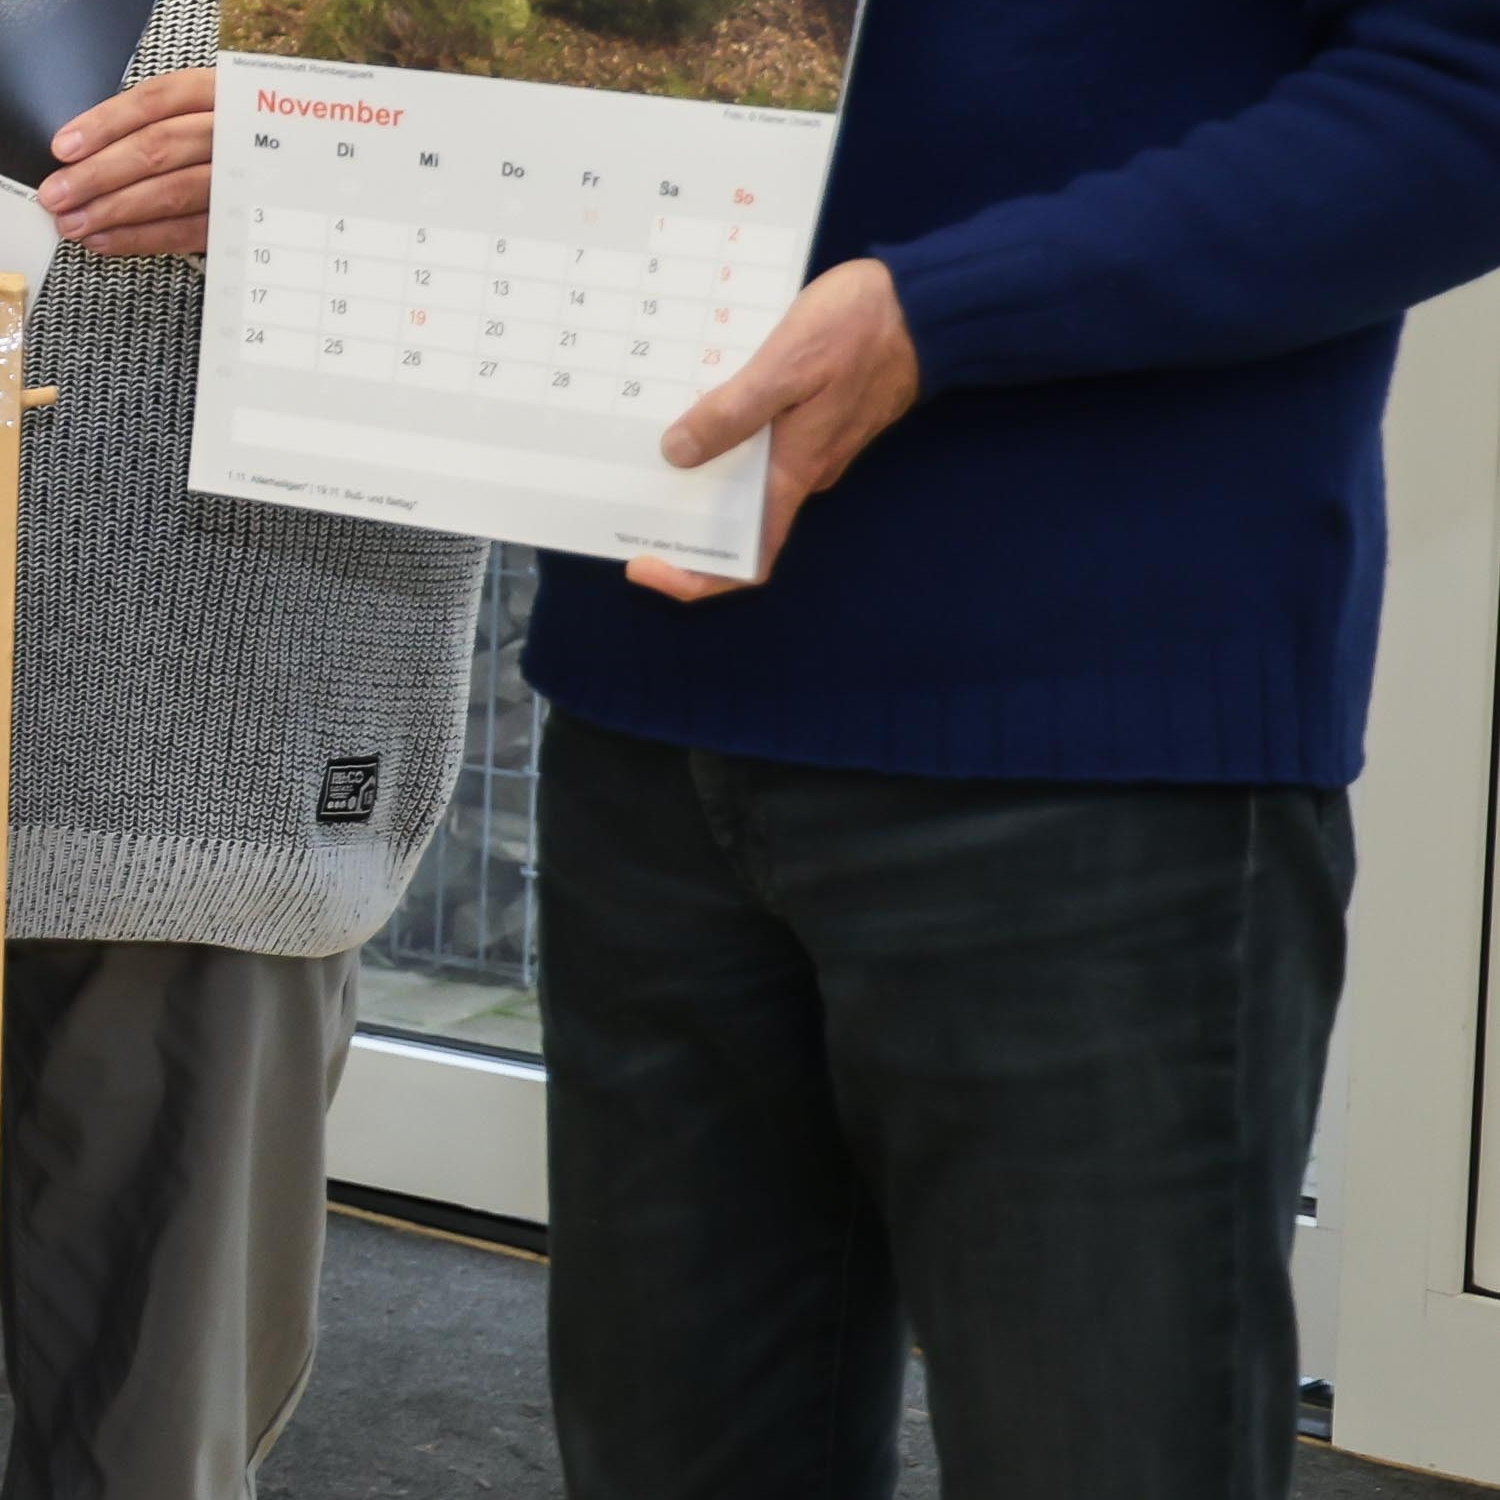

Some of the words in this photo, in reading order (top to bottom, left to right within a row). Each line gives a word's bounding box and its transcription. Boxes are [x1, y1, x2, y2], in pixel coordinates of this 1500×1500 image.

[258, 90, 404, 126] November
[255, 134, 279, 149] Mo
[337, 142, 354, 158] Di
[420, 153, 438, 167] Mi
[502, 162, 525, 178] Do
[582, 172, 600, 187] Fr
[659, 181, 679, 197] Sa
[733, 188, 754, 206] So
[254, 249, 270, 264] 10
[334, 258, 348, 274] 11
[415, 269, 431, 286] 12
[251, 289, 267, 304] 17
[330, 299, 347, 314] 18
[410, 310, 426, 325] 19
[485, 320, 504, 337] 20
[245, 328, 264, 343] 24
[324, 338, 343, 355] 25
[402, 350, 421, 366] 26
[479, 361, 498, 377] 27
